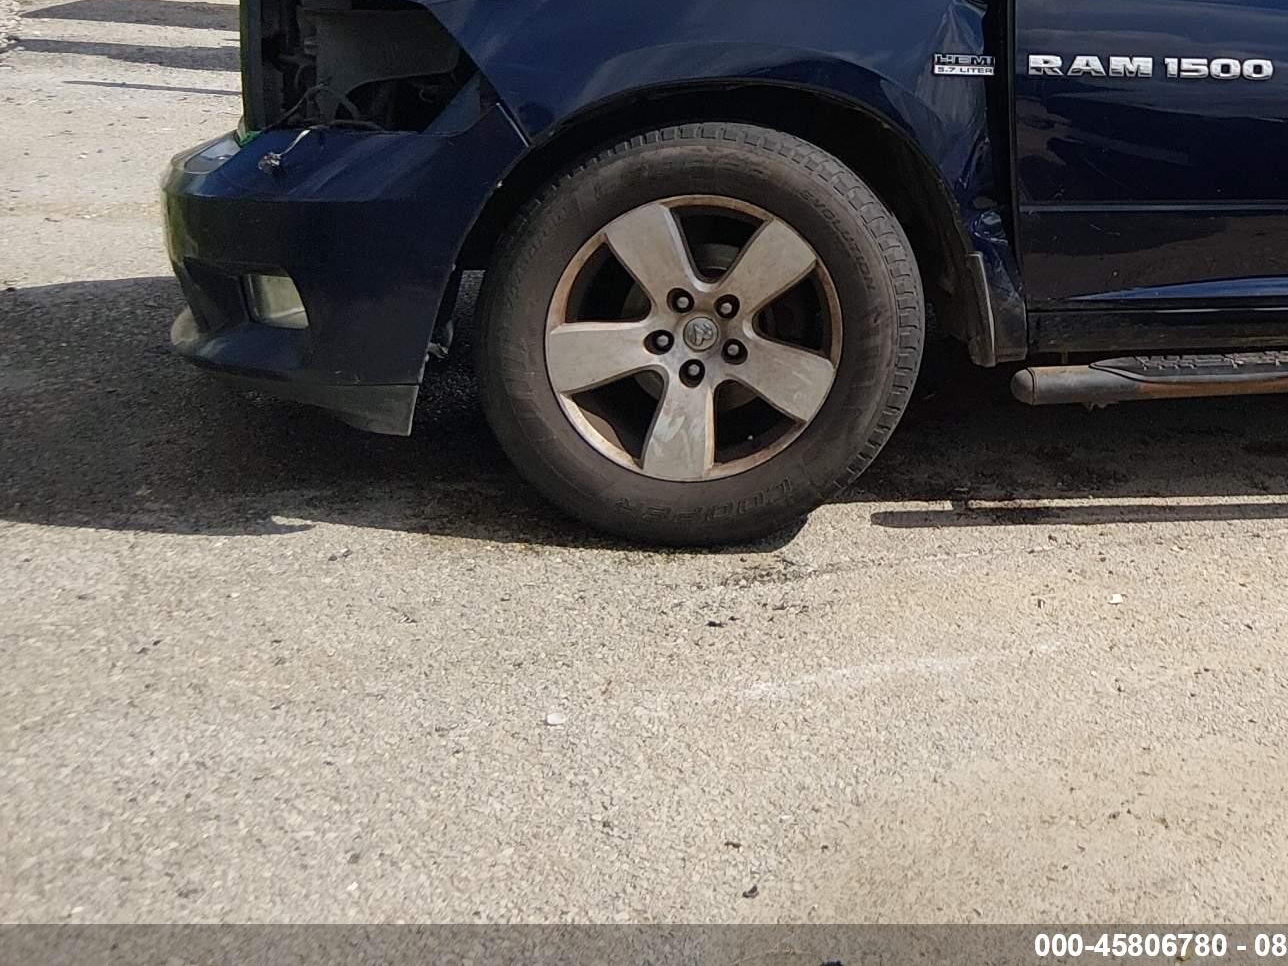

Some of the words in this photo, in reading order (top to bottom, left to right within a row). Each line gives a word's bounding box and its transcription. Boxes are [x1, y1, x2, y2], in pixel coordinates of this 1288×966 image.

[934, 54, 996, 65] HEMI
[1028, 54, 1153, 77] RAM
[1164, 57, 1274, 80] 1500
[800, 190, 876, 290] EVOLUTION
